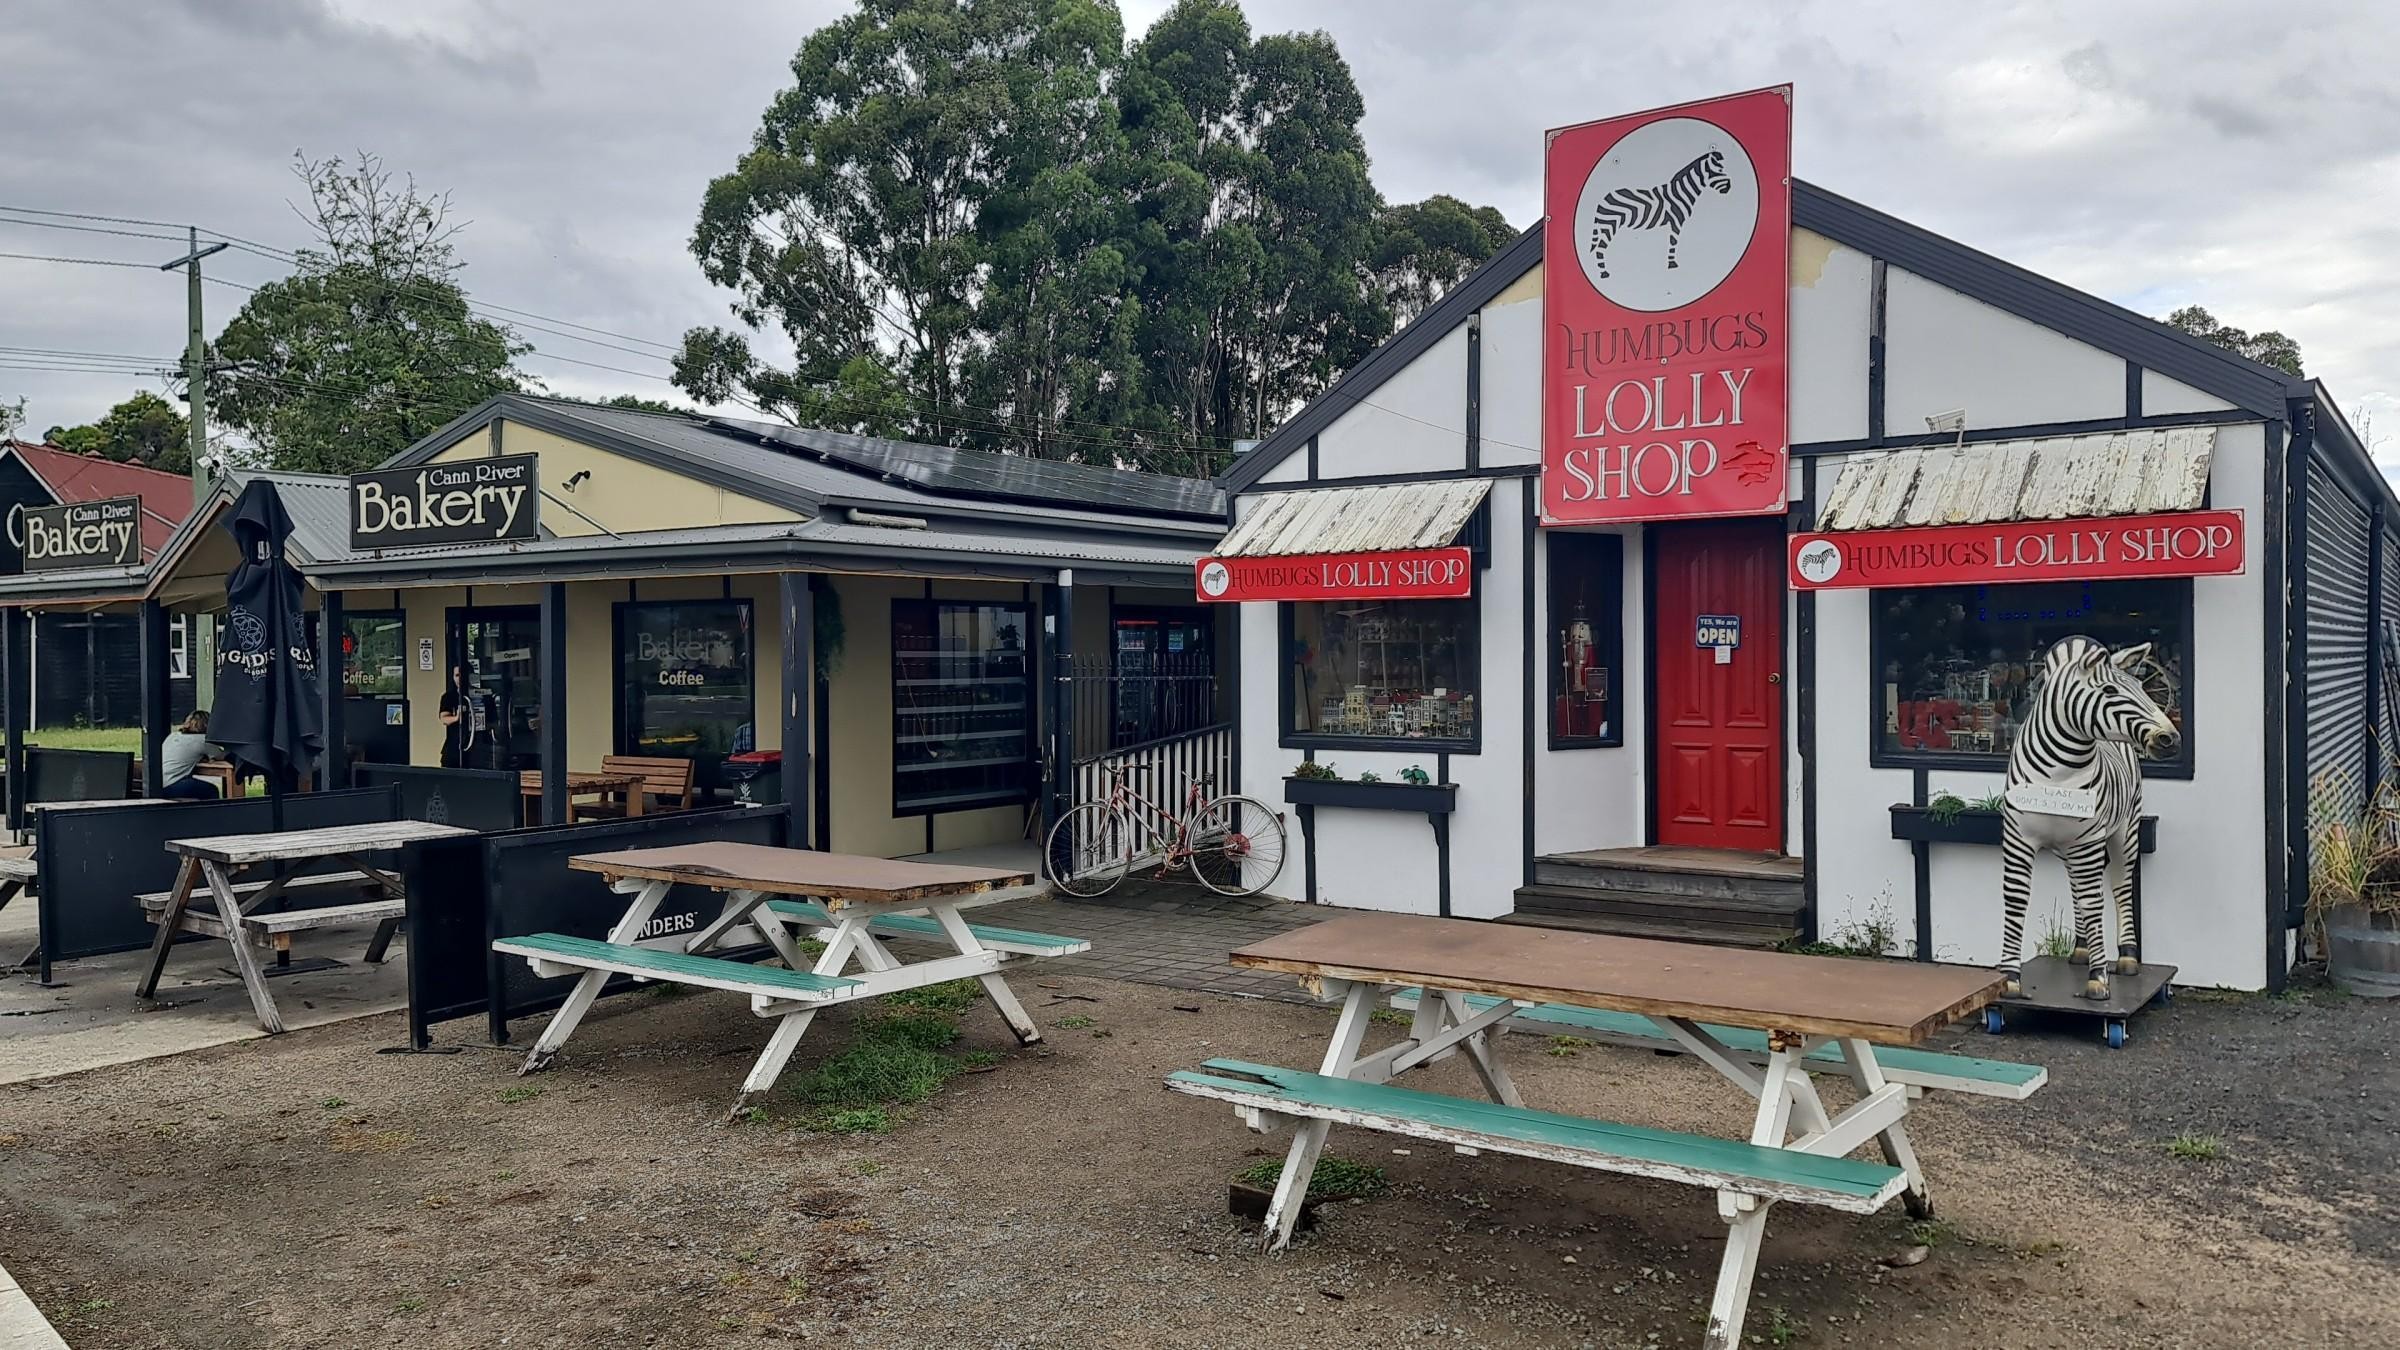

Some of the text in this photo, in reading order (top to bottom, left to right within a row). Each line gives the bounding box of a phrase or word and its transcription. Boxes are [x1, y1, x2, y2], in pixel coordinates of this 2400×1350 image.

[1558, 310, 1769, 378] HUMBUGS
[1573, 367, 1754, 439] LOLLY
[430, 465, 524, 486] Cann River
[1562, 438, 1718, 502] SHOP
[73, 505, 132, 521] Cann River
[357, 470, 527, 538] Bakery
[27, 508, 134, 564] Bakery
[1840, 524, 2232, 578] HUMBUGS LOLLY SHOP
[1229, 558, 1464, 594] HUMBUGS LOLLY SHOP
[1698, 627, 1737, 645] OPEN
[342, 671, 375, 684] Coffee
[658, 670, 705, 686] Coffee
